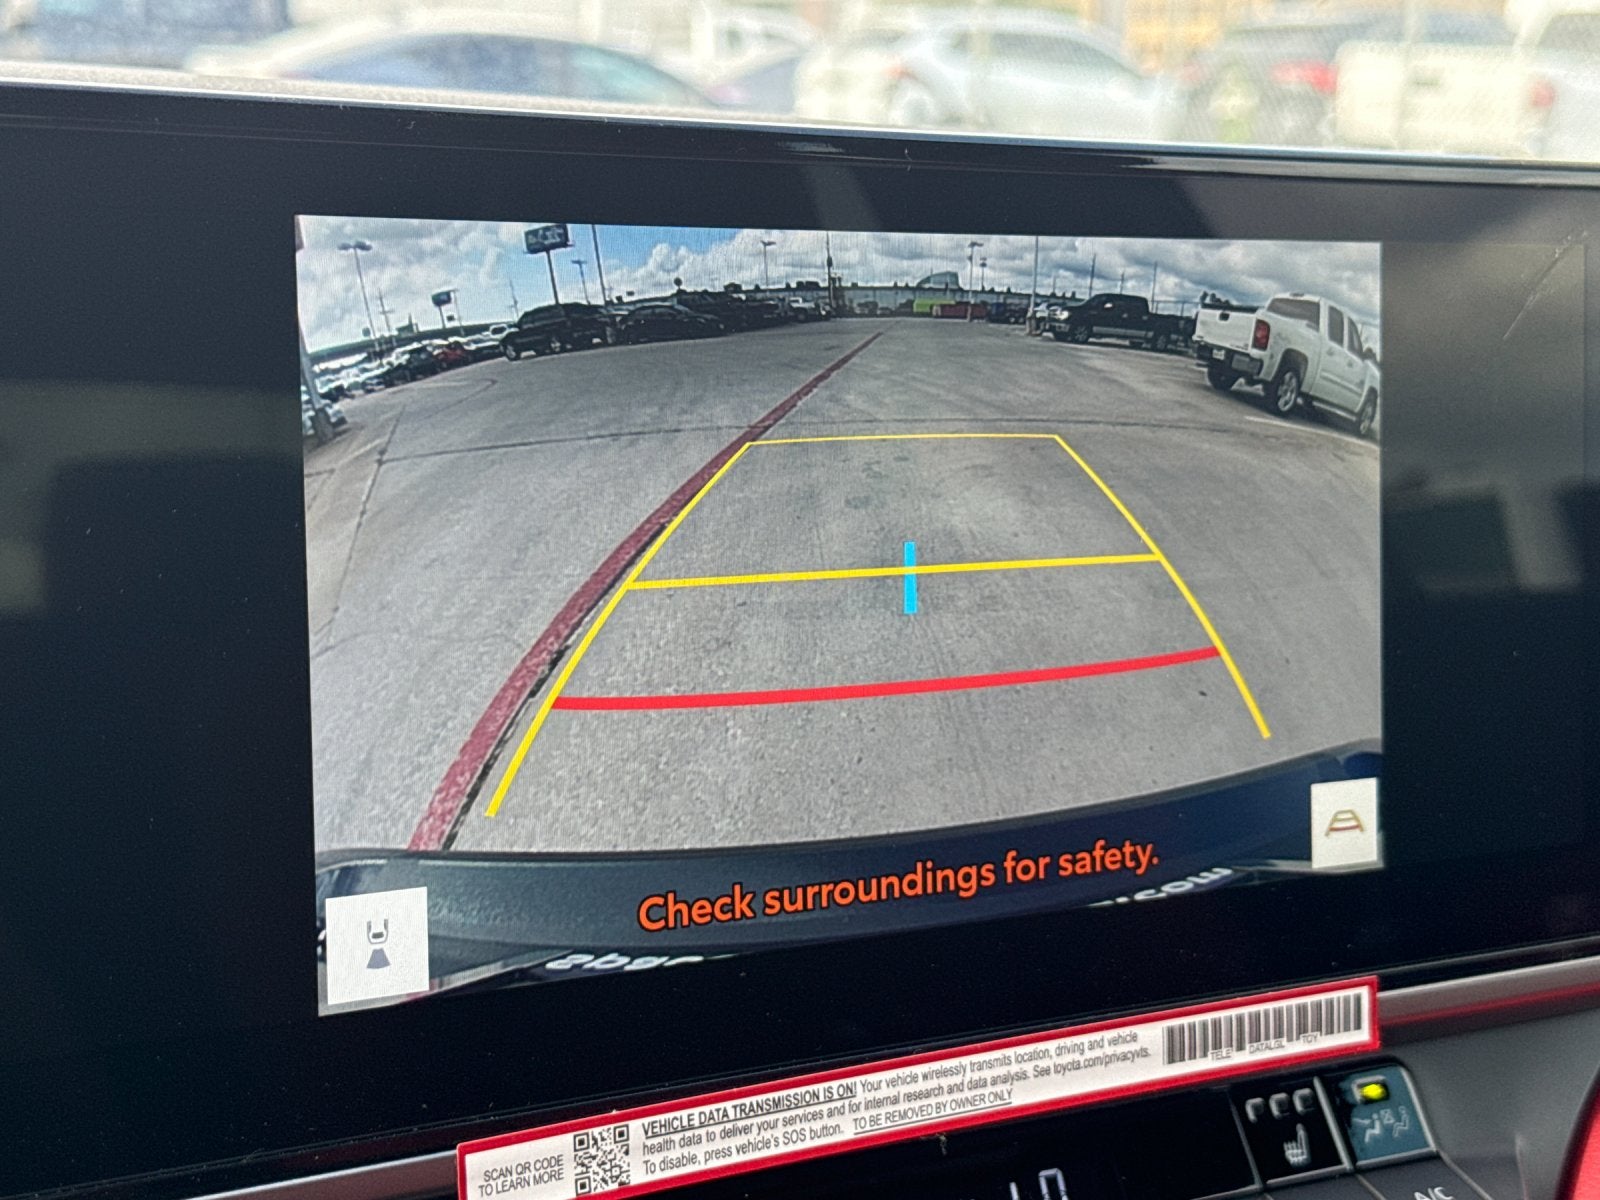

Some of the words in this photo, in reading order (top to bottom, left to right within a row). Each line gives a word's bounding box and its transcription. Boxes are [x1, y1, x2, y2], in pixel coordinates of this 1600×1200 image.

[638, 883, 756, 932] Check
[763, 859, 996, 916] surroundings
[1003, 850, 1051, 883] for
[1058, 839, 1160, 876] safety.
[642, 1113, 695, 1136] VEHICLE
[698, 1106, 729, 1125] DATA
[732, 1088, 820, 1117] TRANSMISSION
[823, 1085, 834, 1100] IS
[836, 1081, 857, 1097] ON!
[860, 1079, 882, 1093] Your
[885, 1071, 919, 1089] vehicle
[921, 1061, 967, 1082] wirelessly
[970, 1053, 1012, 1072] transmits
[1014, 1047, 1053, 1064] location,
[1055, 1040, 1085, 1057] driving
[1087, 1035, 1104, 1050] and
[1107, 1030, 1138, 1047] vehicle
[1210, 1048, 1232, 1061] TELE
[642, 1138, 676, 1156] health
[680, 1131, 702, 1149] data
[706, 1129, 716, 1143] to
[720, 1122, 754, 1140] deliver
[756, 1118, 779, 1136] your
[782, 1109, 824, 1127] services
[826, 1101, 845, 1117] and
[848, 1100, 862, 1114] for
[864, 1091, 900, 1110] internal
[902, 1083, 944, 1103] research
[946, 1080, 965, 1095] and
[967, 1076, 987, 1091] data
[990, 1069, 1030, 1086] analysis.
[1033, 1064, 1051, 1079] See
[642, 1159, 656, 1175] To
[659, 1150, 701, 1173] disable,
[704, 1145, 732, 1165] press
[735, 1134, 780, 1156] vehicle's
[782, 1127, 807, 1146] SOS
[809, 1122, 844, 1140] button.
[853, 1117, 867, 1131] TO
[869, 1113, 882, 1128] BE
[884, 1104, 934, 1124] REMOVED
[935, 1100, 948, 1115] BY
[950, 1093, 986, 1111] OWNER
[988, 1088, 1013, 1104] ONLY
[478, 1183, 494, 1198] TO
[495, 1175, 531, 1194] LEARN
[533, 1168, 564, 1186] MORE
[483, 1165, 513, 1182] SCAN
[515, 1161, 531, 1175] QR
[533, 1154, 564, 1172] CODE
